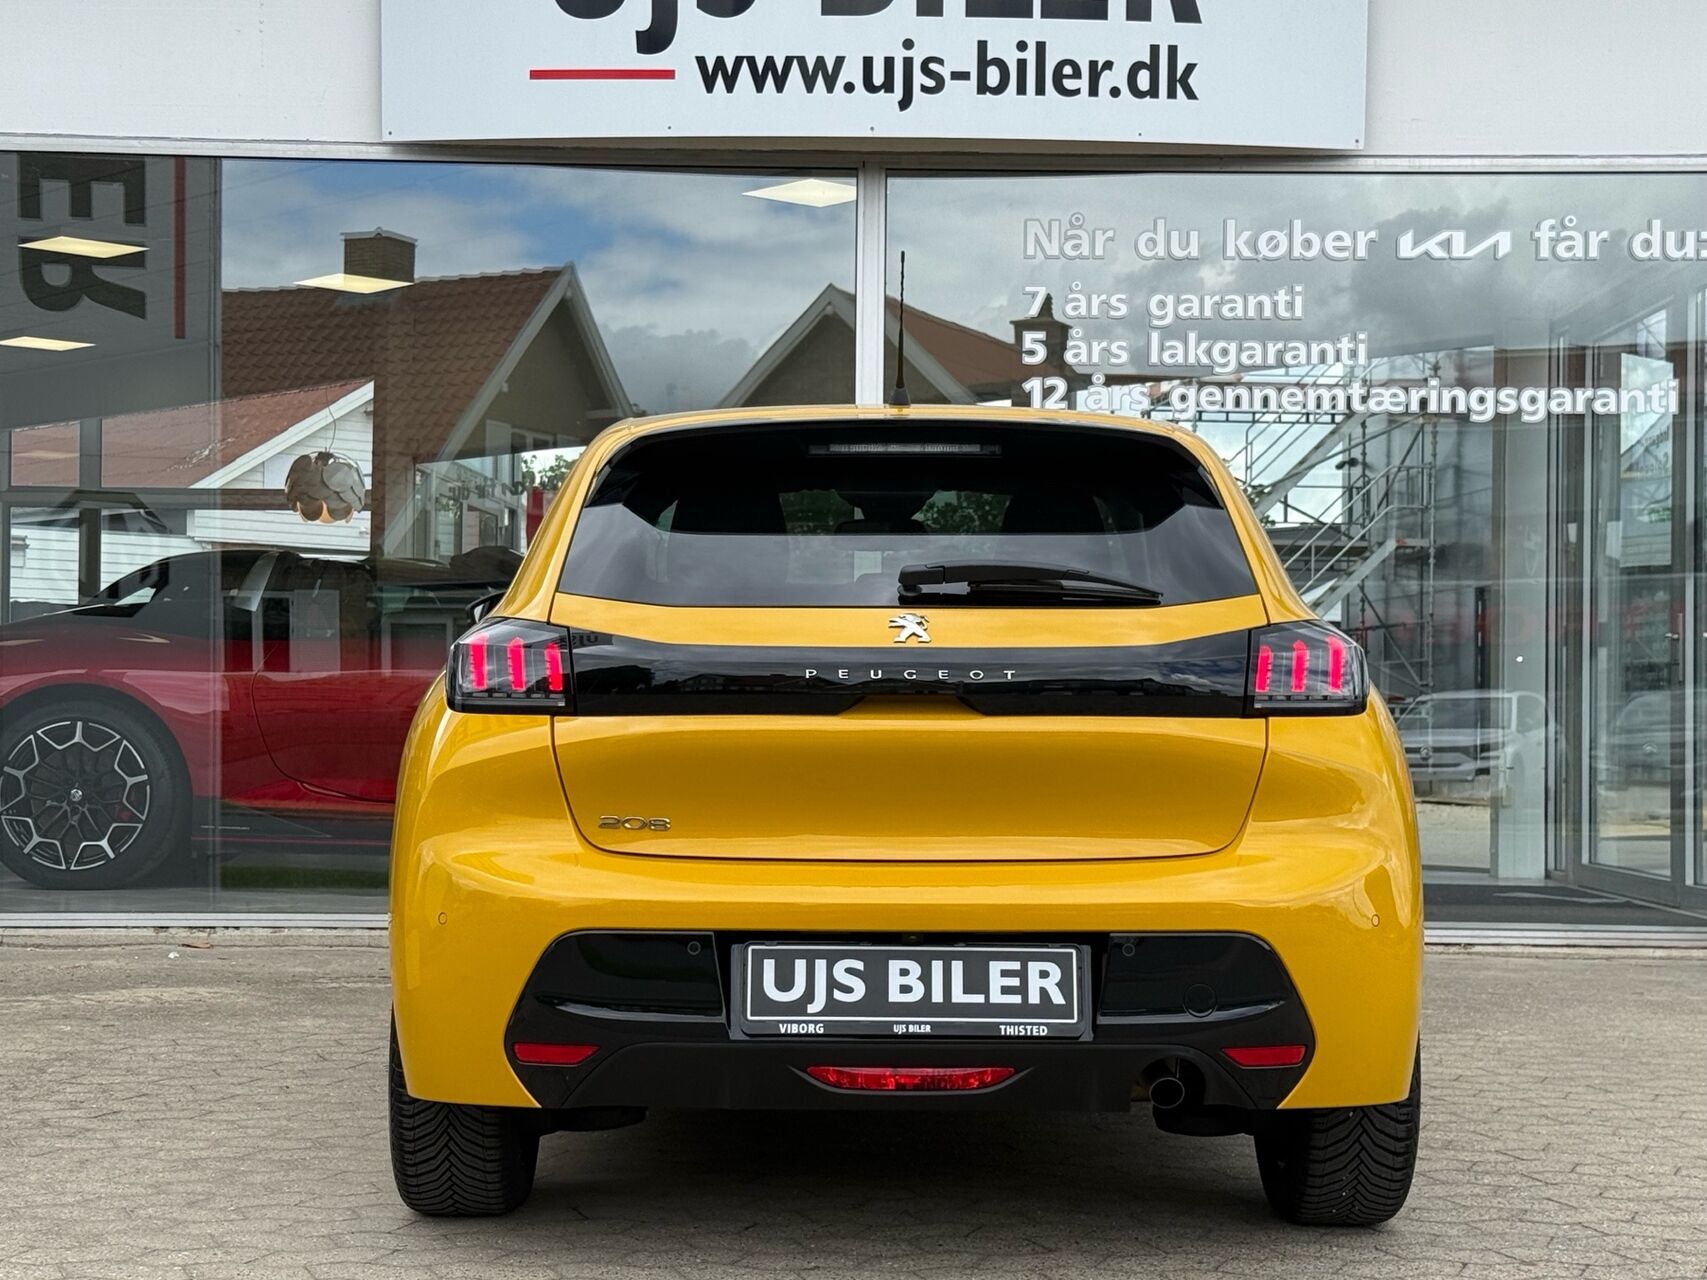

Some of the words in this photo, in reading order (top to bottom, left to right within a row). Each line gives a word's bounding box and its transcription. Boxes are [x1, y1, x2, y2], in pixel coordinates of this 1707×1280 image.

[695, 38, 1199, 112] www.ujs-biler.dk
[1023, 212, 1115, 260] Når
[1134, 217, 1200, 260] du
[1222, 217, 1378, 261] køber
[1531, 215, 1610, 261] får
[1022, 286, 1047, 319] 7
[1063, 281, 1130, 319] års
[1146, 283, 1305, 328] garanti
[1021, 331, 1047, 365] 5
[1063, 328, 1130, 365] års
[1148, 330, 1368, 375] lakgaranti
[1021, 376, 1068, 409] 12
[1084, 372, 1151, 412] års
[1168, 377, 1680, 424] gennemtæringsgaranti
[804, 668, 1016, 681] PEUGEOT
[598, 815, 671, 831] 208
[763, 958, 867, 1014] UJS
[888, 959, 1067, 1005] BILER
[778, 1022, 825, 1035] VIBORG
[893, 1024, 907, 1035] UJS
[908, 1024, 931, 1033] BILER
[999, 1024, 1049, 1037] THISTED
